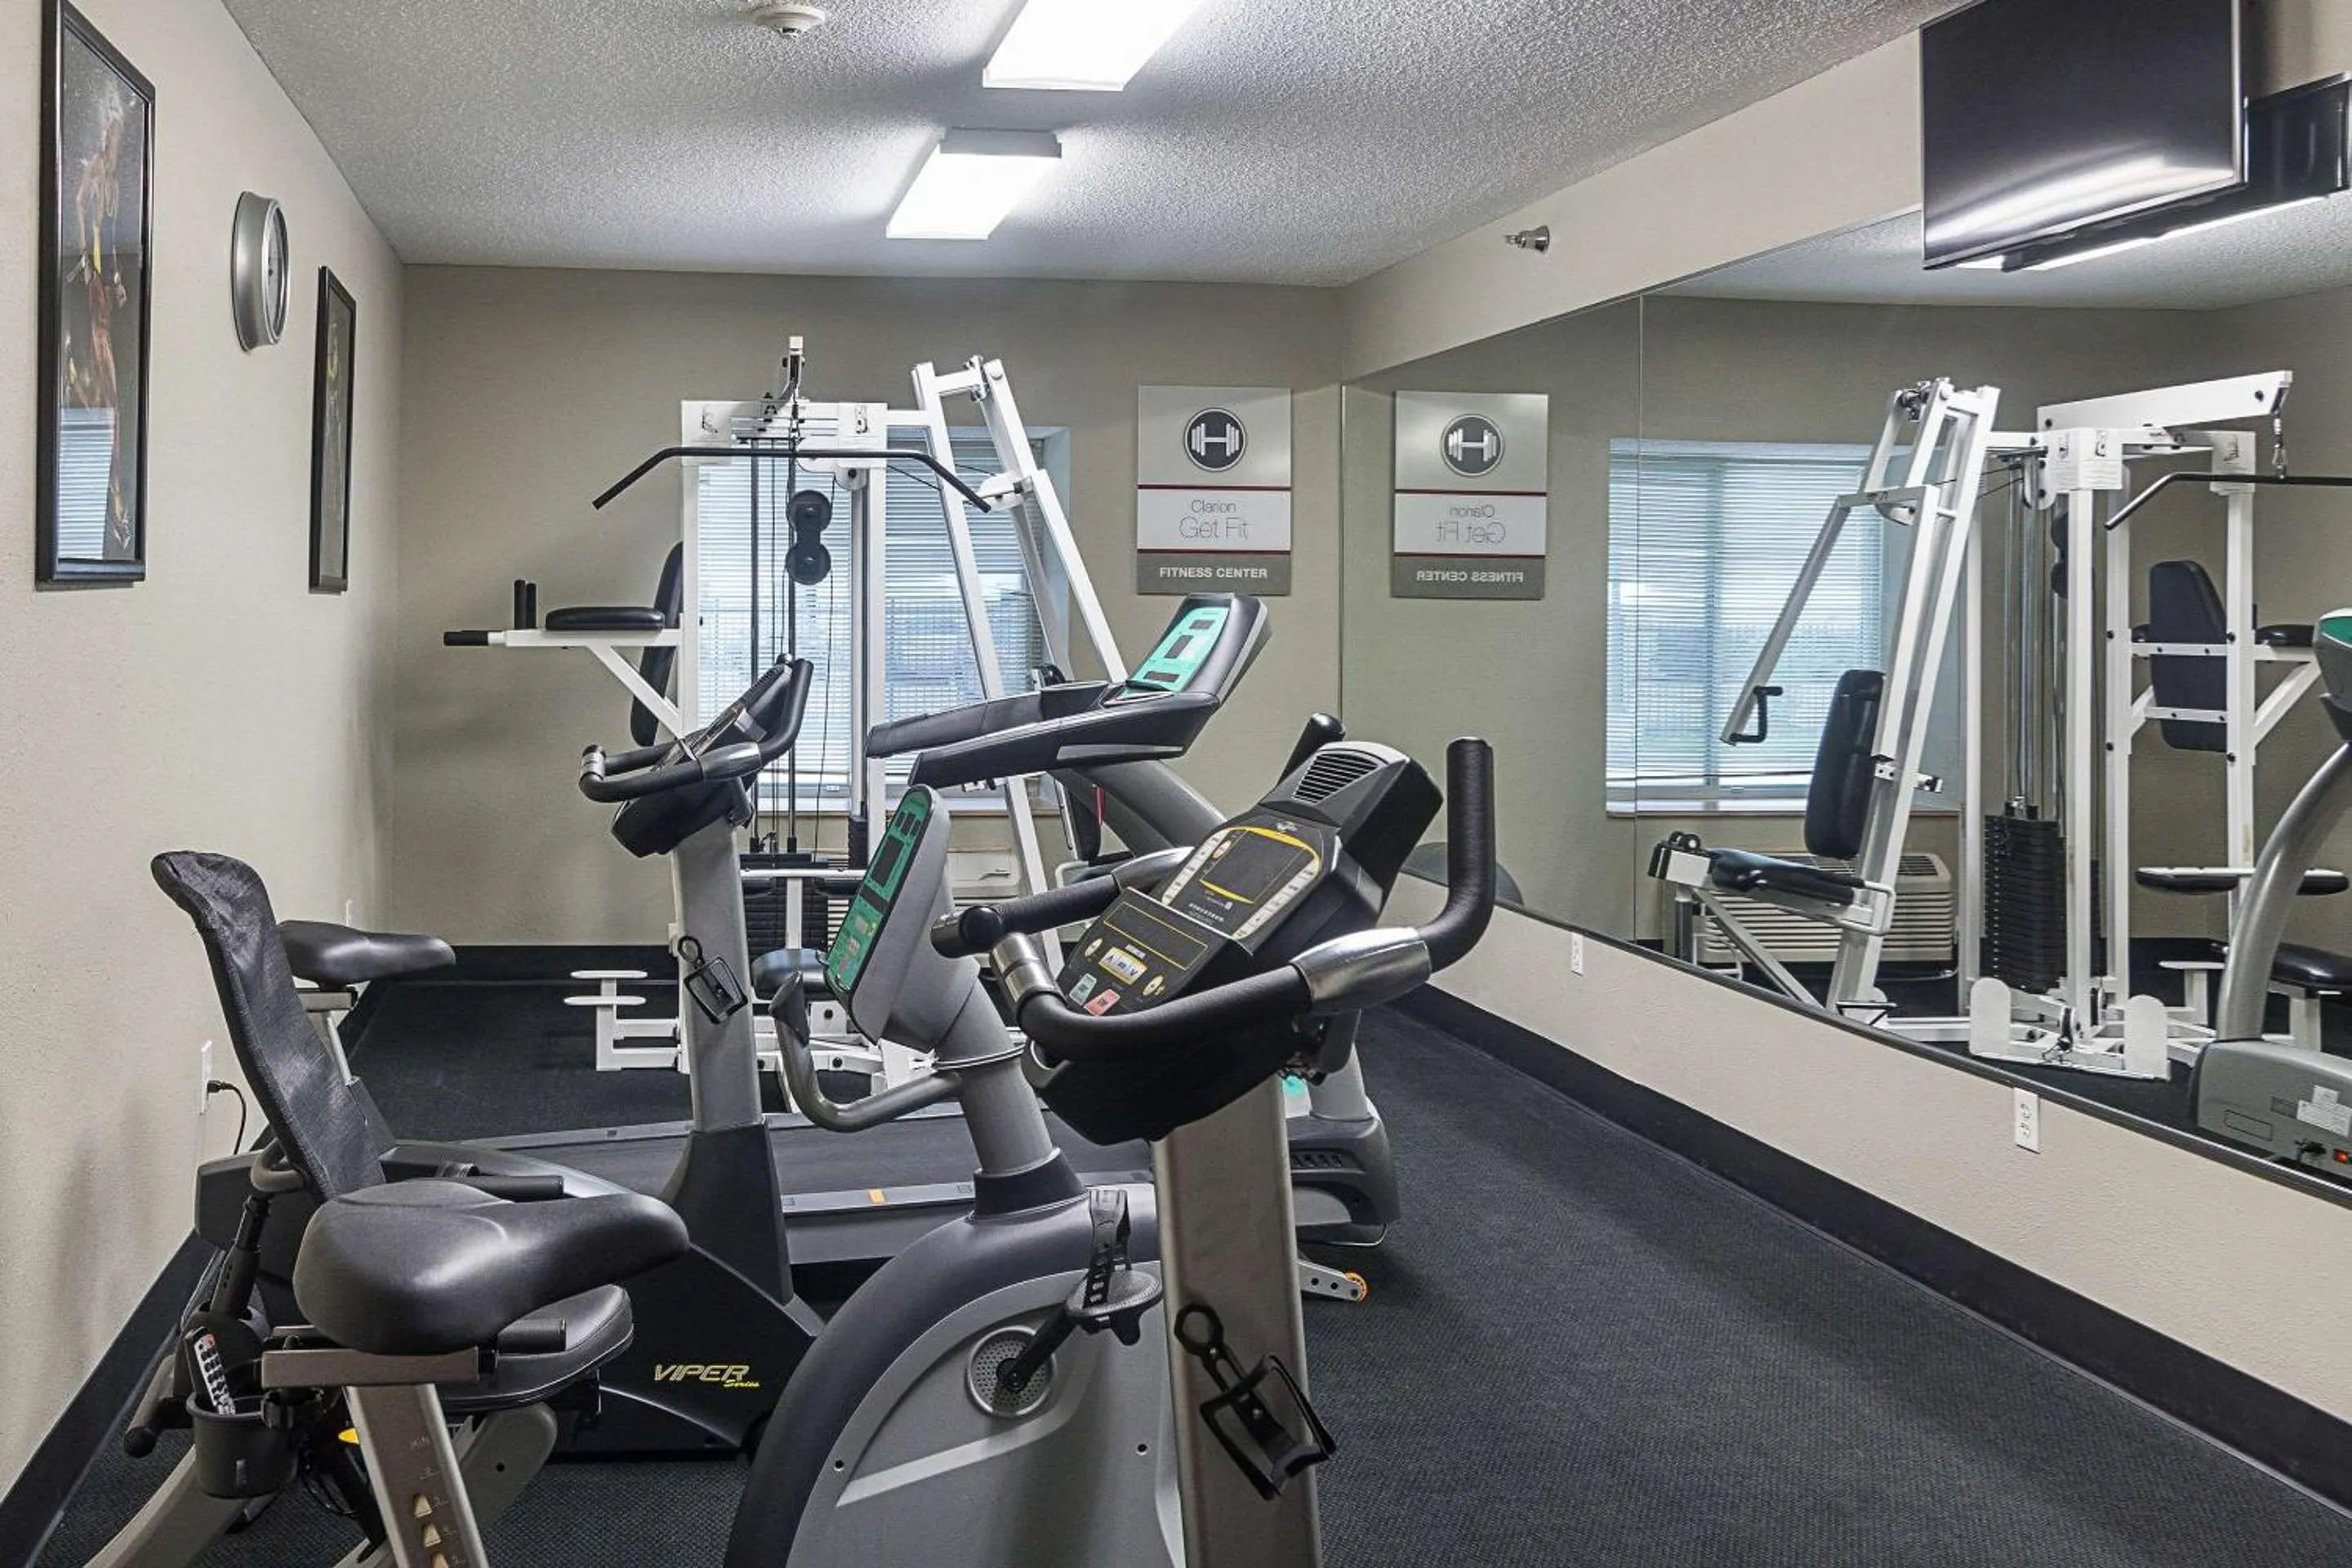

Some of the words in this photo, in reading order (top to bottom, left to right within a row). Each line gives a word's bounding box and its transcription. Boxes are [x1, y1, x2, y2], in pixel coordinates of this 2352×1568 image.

[1191, 499, 1236, 514] Clarion
[1179, 515, 1219, 539] Get
[1226, 516, 1251, 540] Fit
[1159, 567, 1213, 578] FITNESS
[1216, 567, 1268, 578] CENTER
[654, 1363, 751, 1382] VIPER
